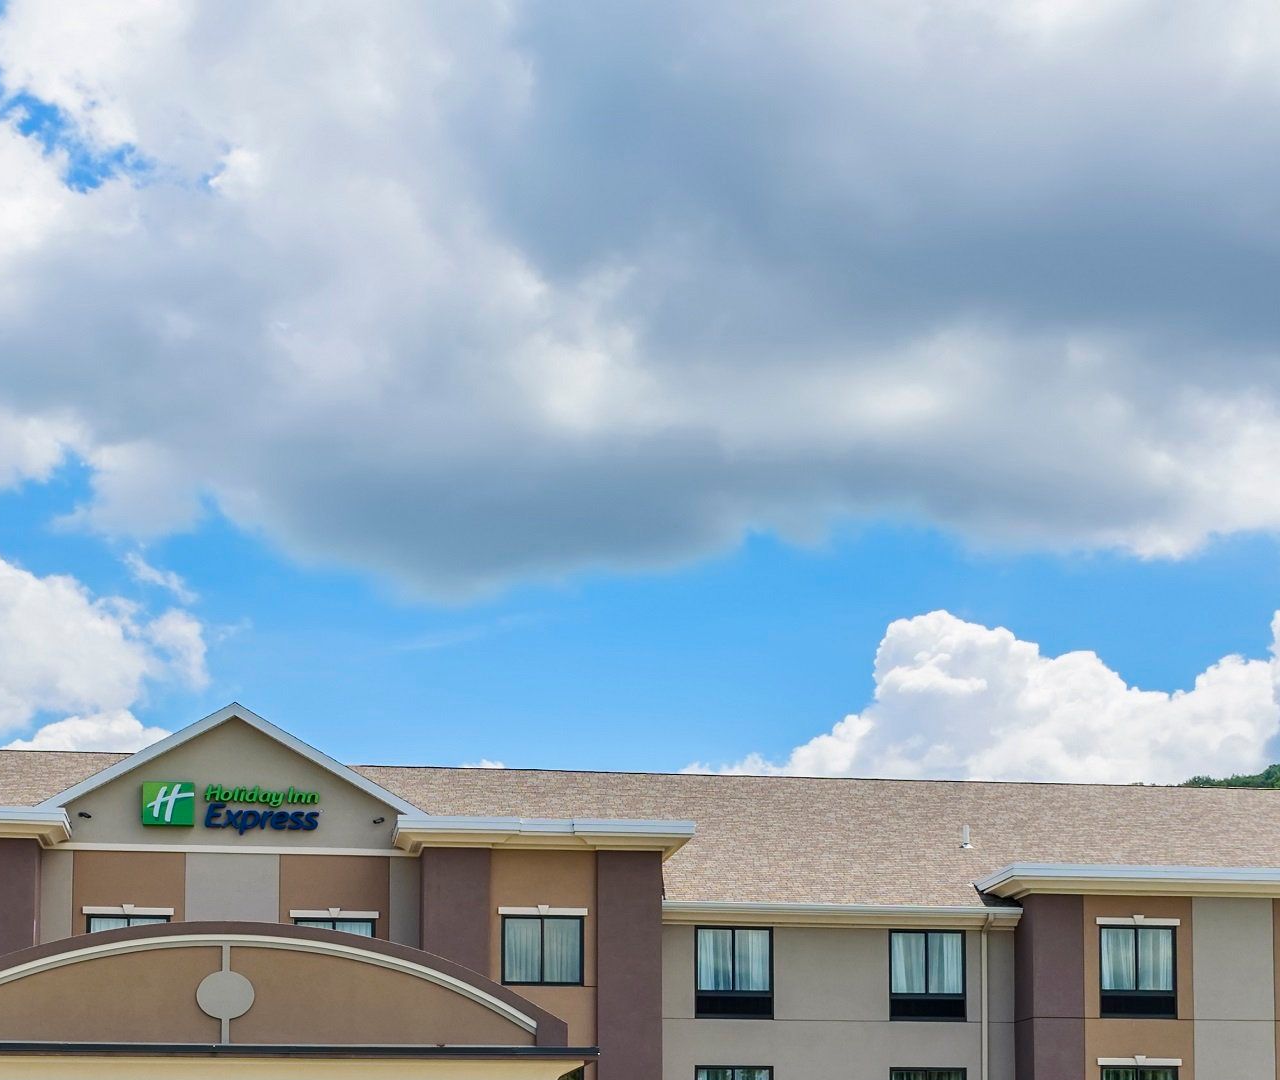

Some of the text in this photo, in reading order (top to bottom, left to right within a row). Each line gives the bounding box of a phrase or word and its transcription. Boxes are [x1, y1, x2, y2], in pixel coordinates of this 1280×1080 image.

[205, 784, 319, 808] Holiday Inn
[204, 802, 320, 835] Express
